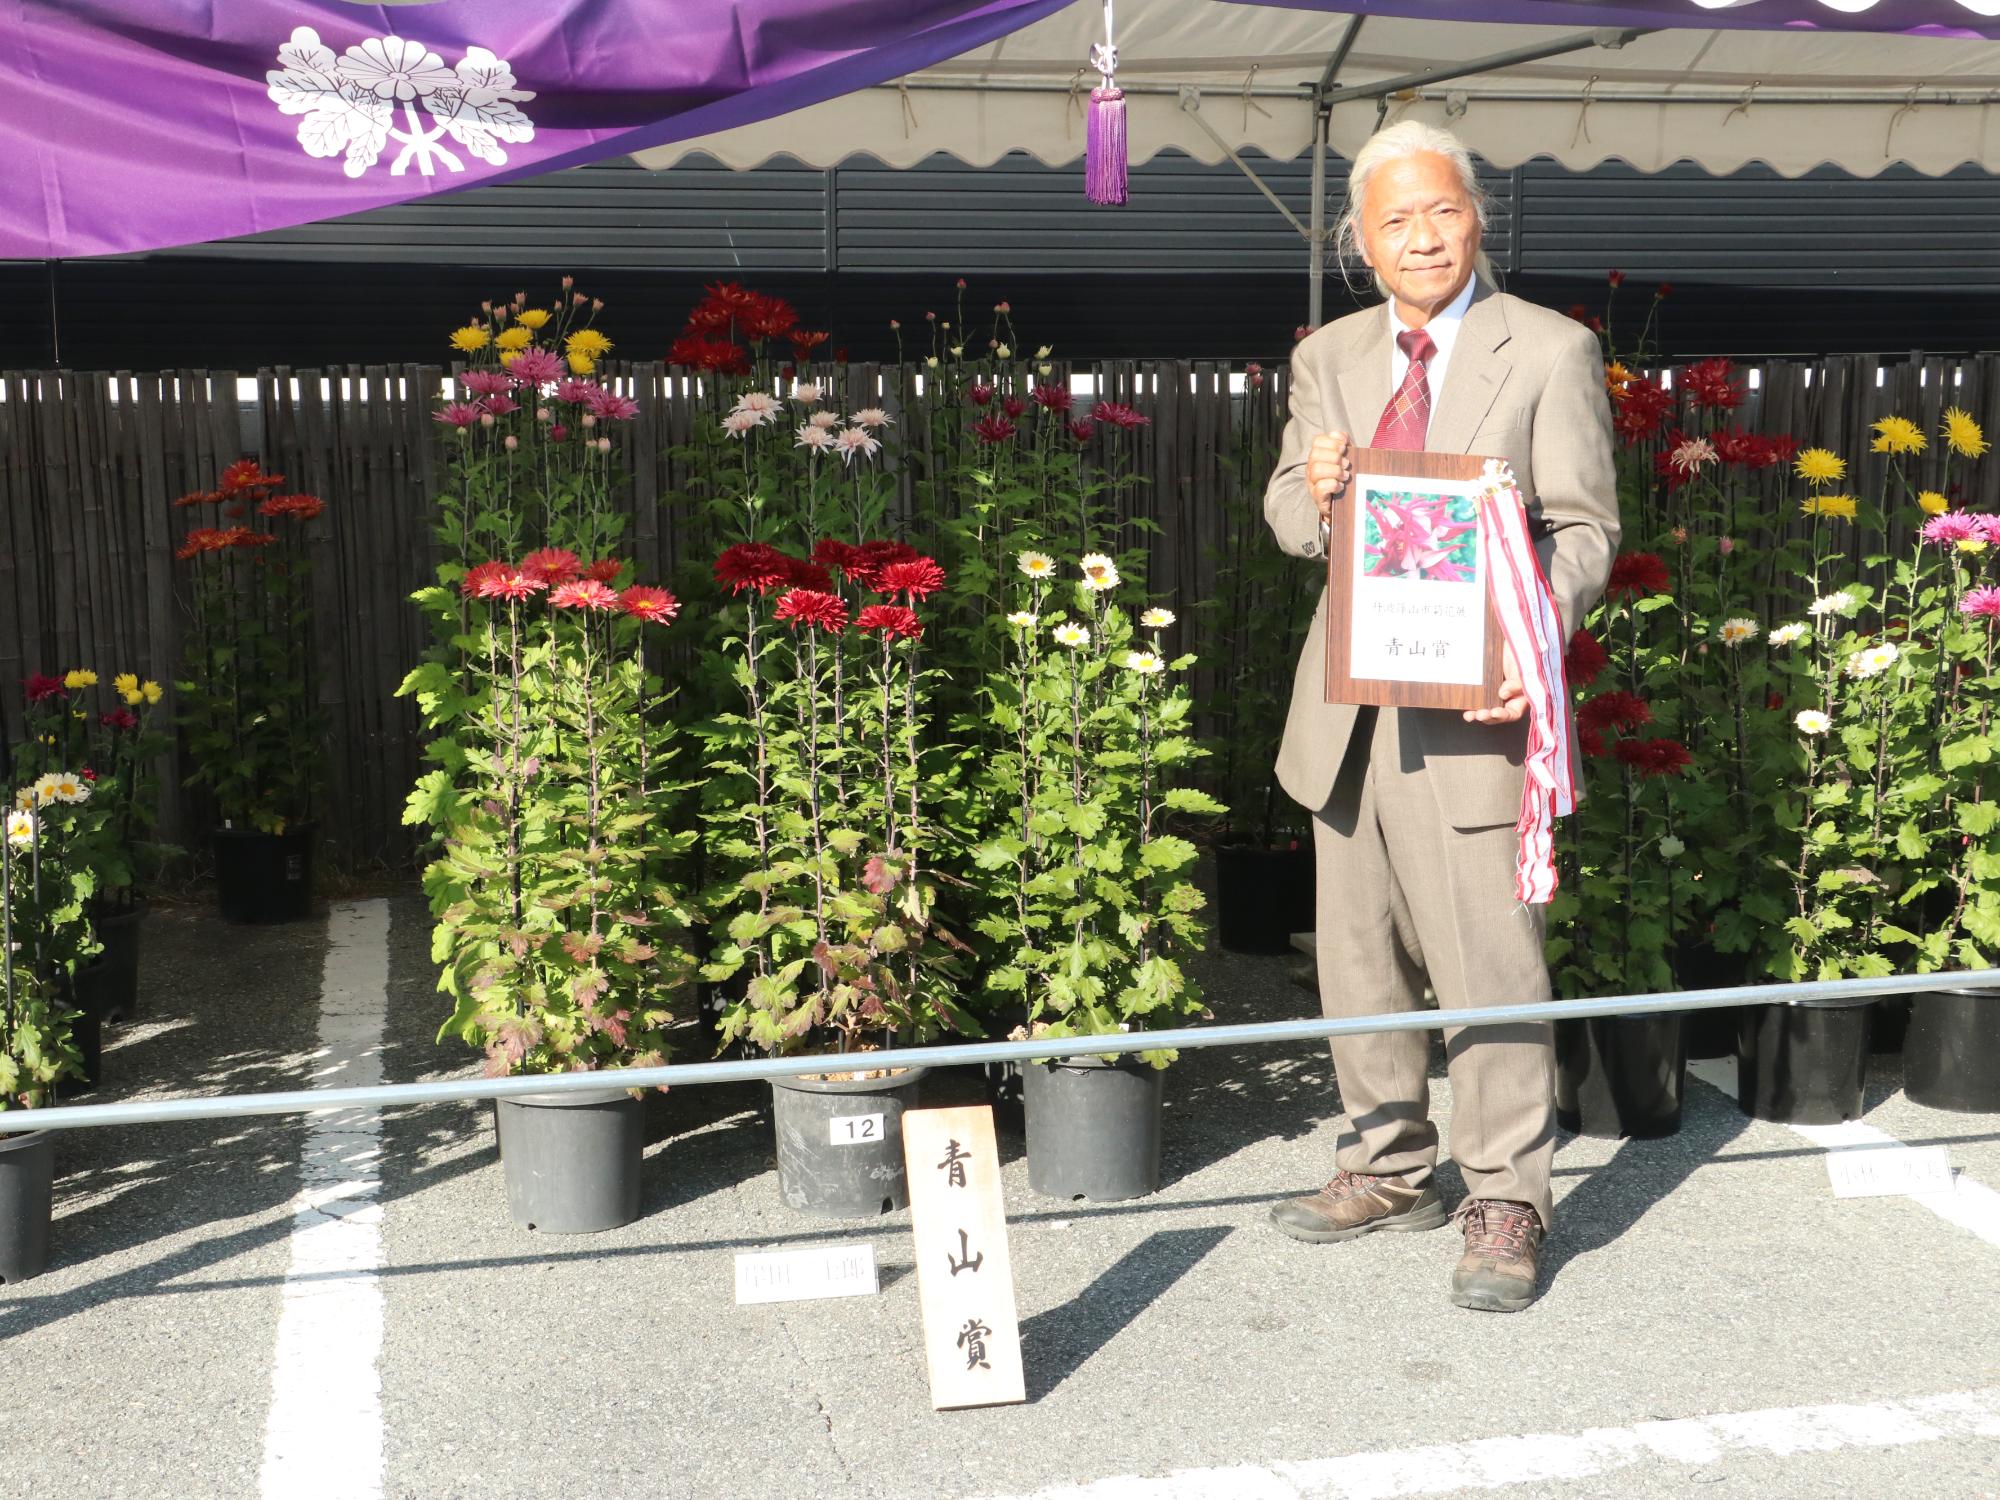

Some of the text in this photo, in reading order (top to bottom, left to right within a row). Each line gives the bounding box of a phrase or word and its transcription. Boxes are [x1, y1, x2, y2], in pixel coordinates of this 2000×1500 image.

[1384, 637, 1450, 658] 青山賞
[845, 1119, 874, 1138] 12
[937, 1139, 993, 1370] 青山賞
